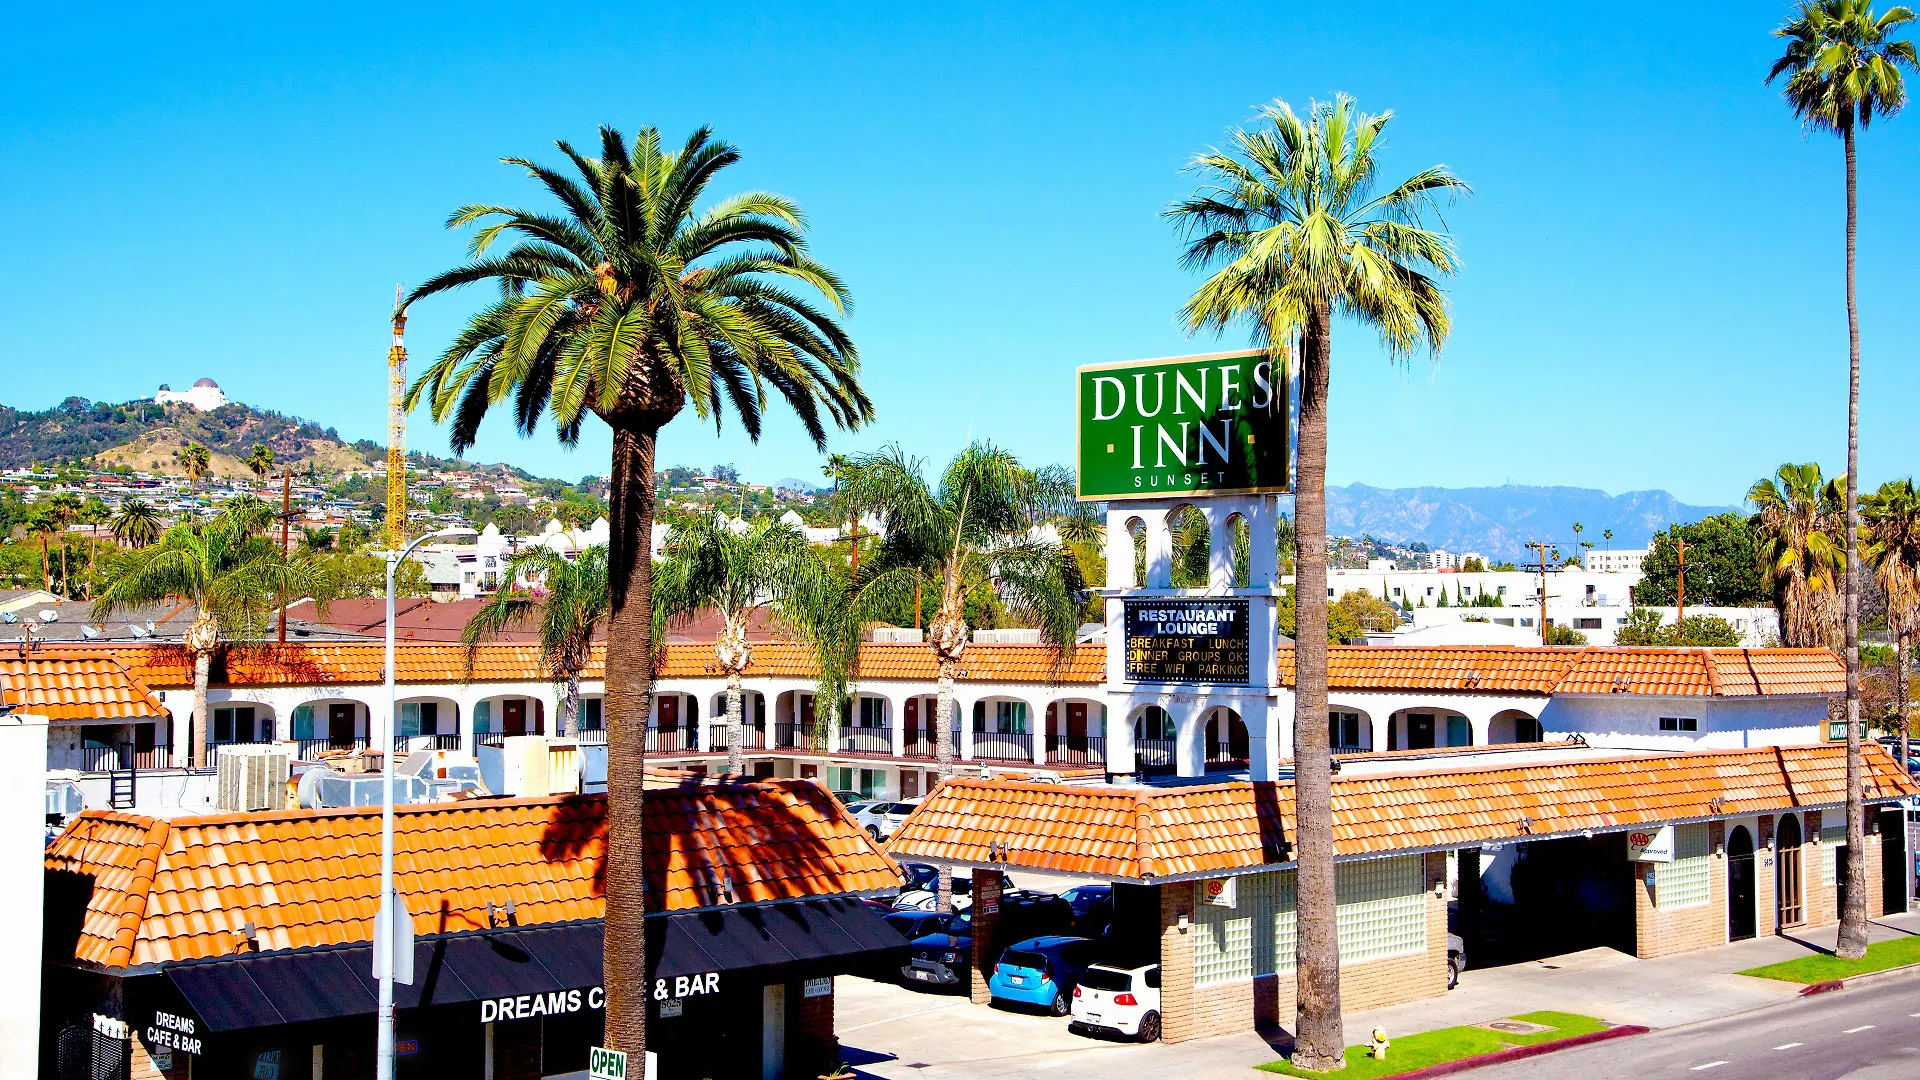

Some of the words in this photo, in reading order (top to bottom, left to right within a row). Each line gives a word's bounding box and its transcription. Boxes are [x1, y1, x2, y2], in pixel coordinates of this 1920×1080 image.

[1092, 361, 1273, 421] DUNES
[1130, 418, 1233, 469] INN
[1134, 471, 1225, 488] SUNSET
[1138, 609, 1236, 622] RESTAURANT
[1157, 622, 1218, 635] LOUNGE
[1130, 637, 1194, 649] BREAKFAST
[1209, 638, 1244, 650] LUNCH
[1129, 650, 1168, 661] DINNER
[1178, 651, 1221, 662] GROUPS
[1228, 651, 1244, 662] OK
[1129, 663, 1157, 674] FREE
[1165, 663, 1185, 674] WIFI
[1198, 664, 1245, 675] PARKING
[1630, 833, 1649, 846] AAA
[1640, 846, 1668, 855] Approved
[480, 987, 582, 1023] DREAMS
[653, 978, 668, 1000] &
[675, 972, 720, 998] BAR
[155, 1010, 195, 1034] DREAMS
[147, 1027, 171, 1047] CAFE
[172, 1034, 180, 1049] &
[181, 1036, 201, 1055] BAR
[592, 1049, 624, 1077] OPEN
